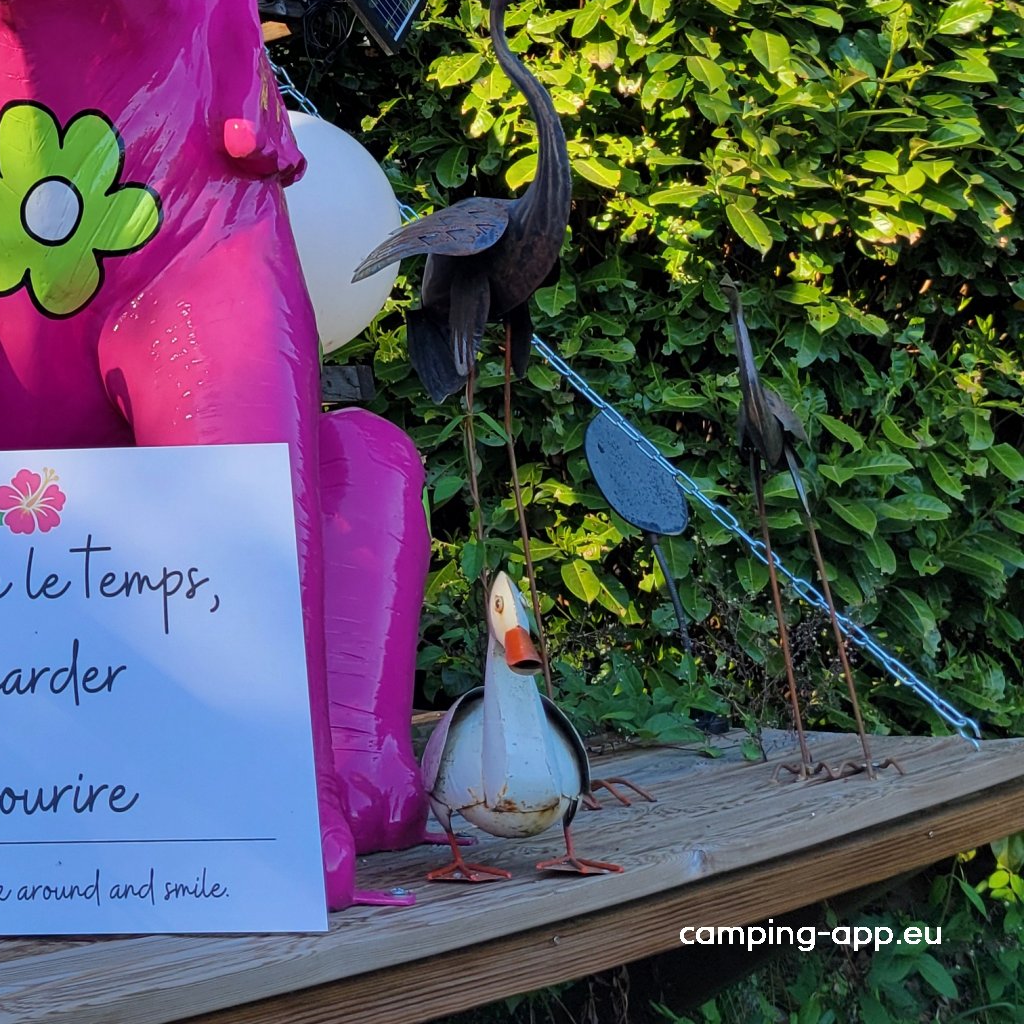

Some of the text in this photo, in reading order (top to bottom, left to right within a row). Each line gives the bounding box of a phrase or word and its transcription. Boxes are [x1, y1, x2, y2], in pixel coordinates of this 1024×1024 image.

[26, 547, 72, 601] le
[16, 868, 101, 906] around
[109, 868, 156, 906] and
[164, 867, 230, 901] smile.
